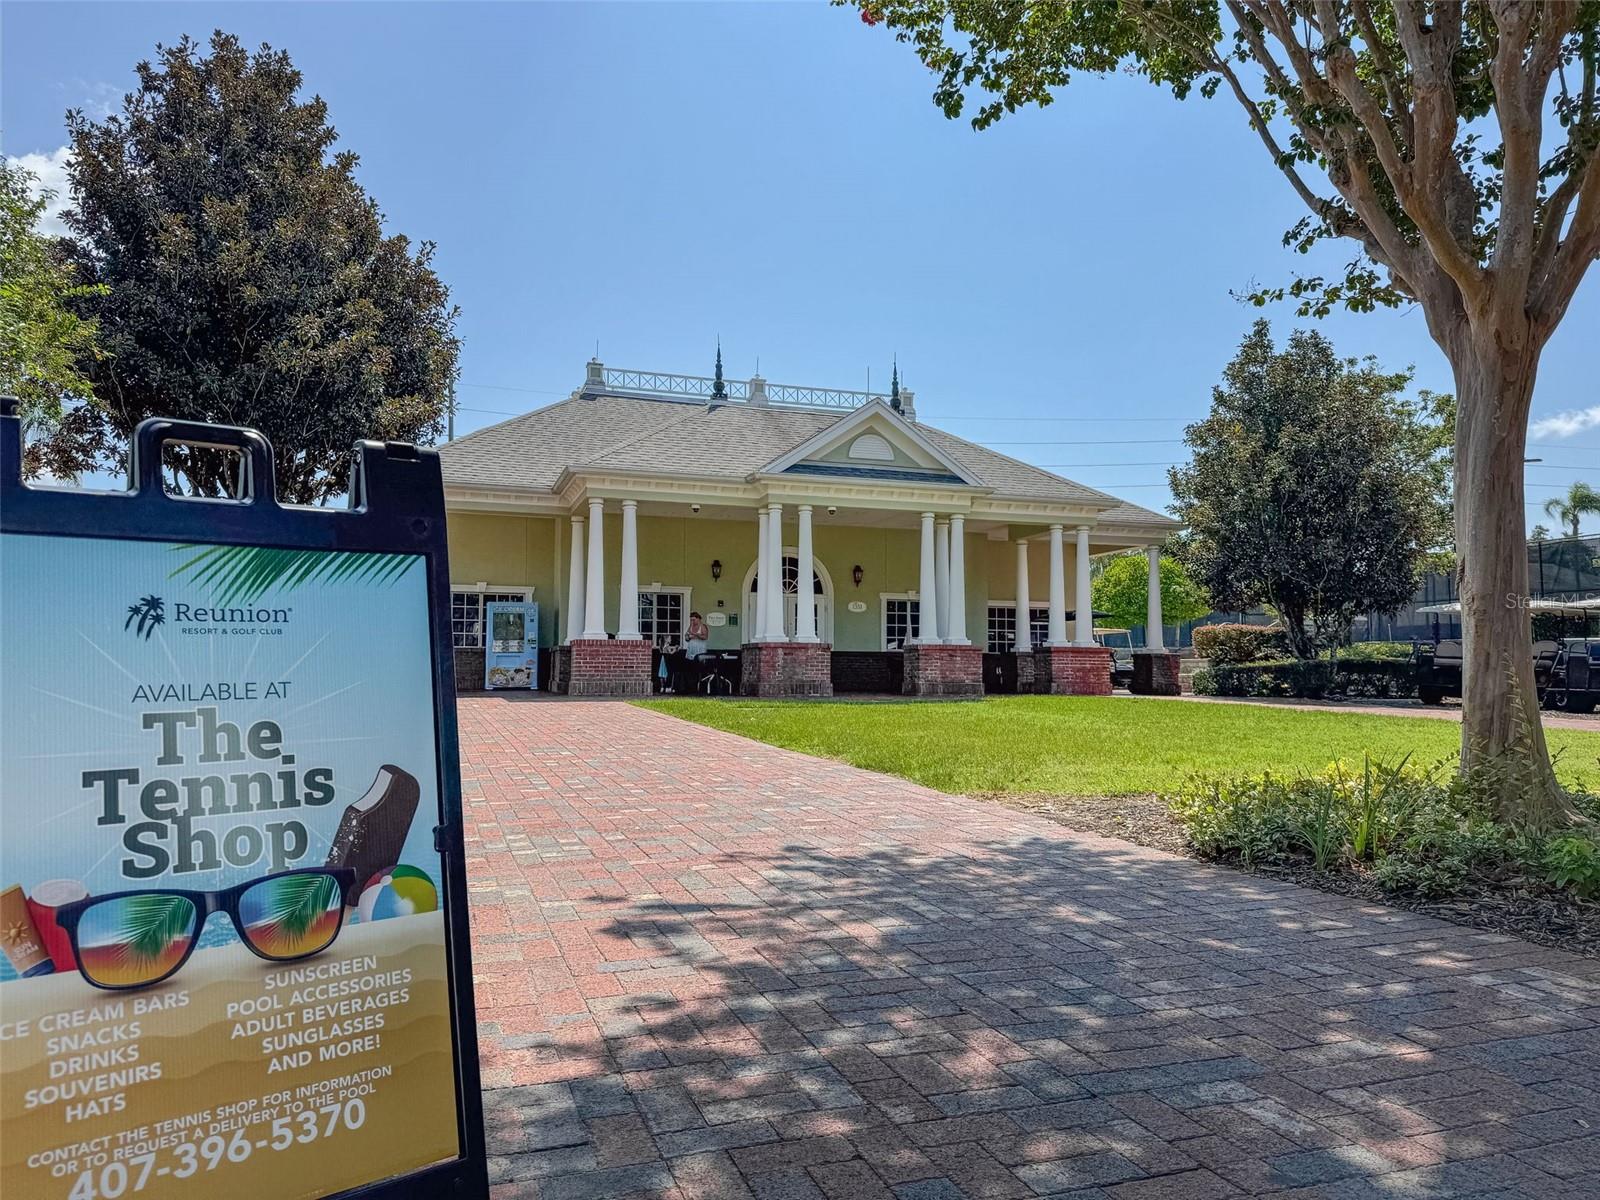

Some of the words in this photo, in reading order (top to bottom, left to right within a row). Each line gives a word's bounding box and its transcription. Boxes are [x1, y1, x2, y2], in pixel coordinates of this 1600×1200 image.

[131, 682, 258, 703] AVAILABLE
[264, 681, 292, 699] AT
[142, 707, 283, 766] The
[82, 754, 336, 826] Tennis
[121, 810, 309, 879] Shop
[227, 994, 283, 1019] POOL
[289, 968, 412, 1007] ACCESSORIES
[264, 955, 377, 990] SUNSCREEN
[0, 1020, 30, 1041] CE
[38, 1002, 125, 1033] CREAM
[133, 990, 190, 1015] BARS
[46, 1021, 142, 1056] SNACKS
[230, 1012, 296, 1040] ADULT
[302, 988, 410, 1024] BEVERAGES
[262, 1013, 385, 1054] SUNGLASSES
[50, 1044, 140, 1079] DRINKS
[267, 1050, 312, 1074] AND
[319, 1034, 381, 1062] MORE!
[24, 1062, 162, 1109] SOUVENIRS
[65, 1093, 126, 1123] HATS
[27, 1135, 112, 1169] CONTACT
[115, 1126, 149, 1145] THE
[153, 1109, 212, 1135] TENNIS
[216, 1099, 258, 1119] SHOP
[262, 1091, 292, 1108] FOR
[296, 1065, 392, 1099] INFORMATION
[52, 1160, 79, 1177] OR
[84, 1152, 108, 1169] TO
[113, 1130, 189, 1161] REQUEST
[192, 1127, 205, 1140] A
[209, 1106, 281, 1136] DELIVERY
[284, 1101, 305, 1115] TO
[307, 1092, 336, 1109] THE
[338, 1082, 377, 1101] POOL
[67, 1098, 366, 1200] 407-396-5370
